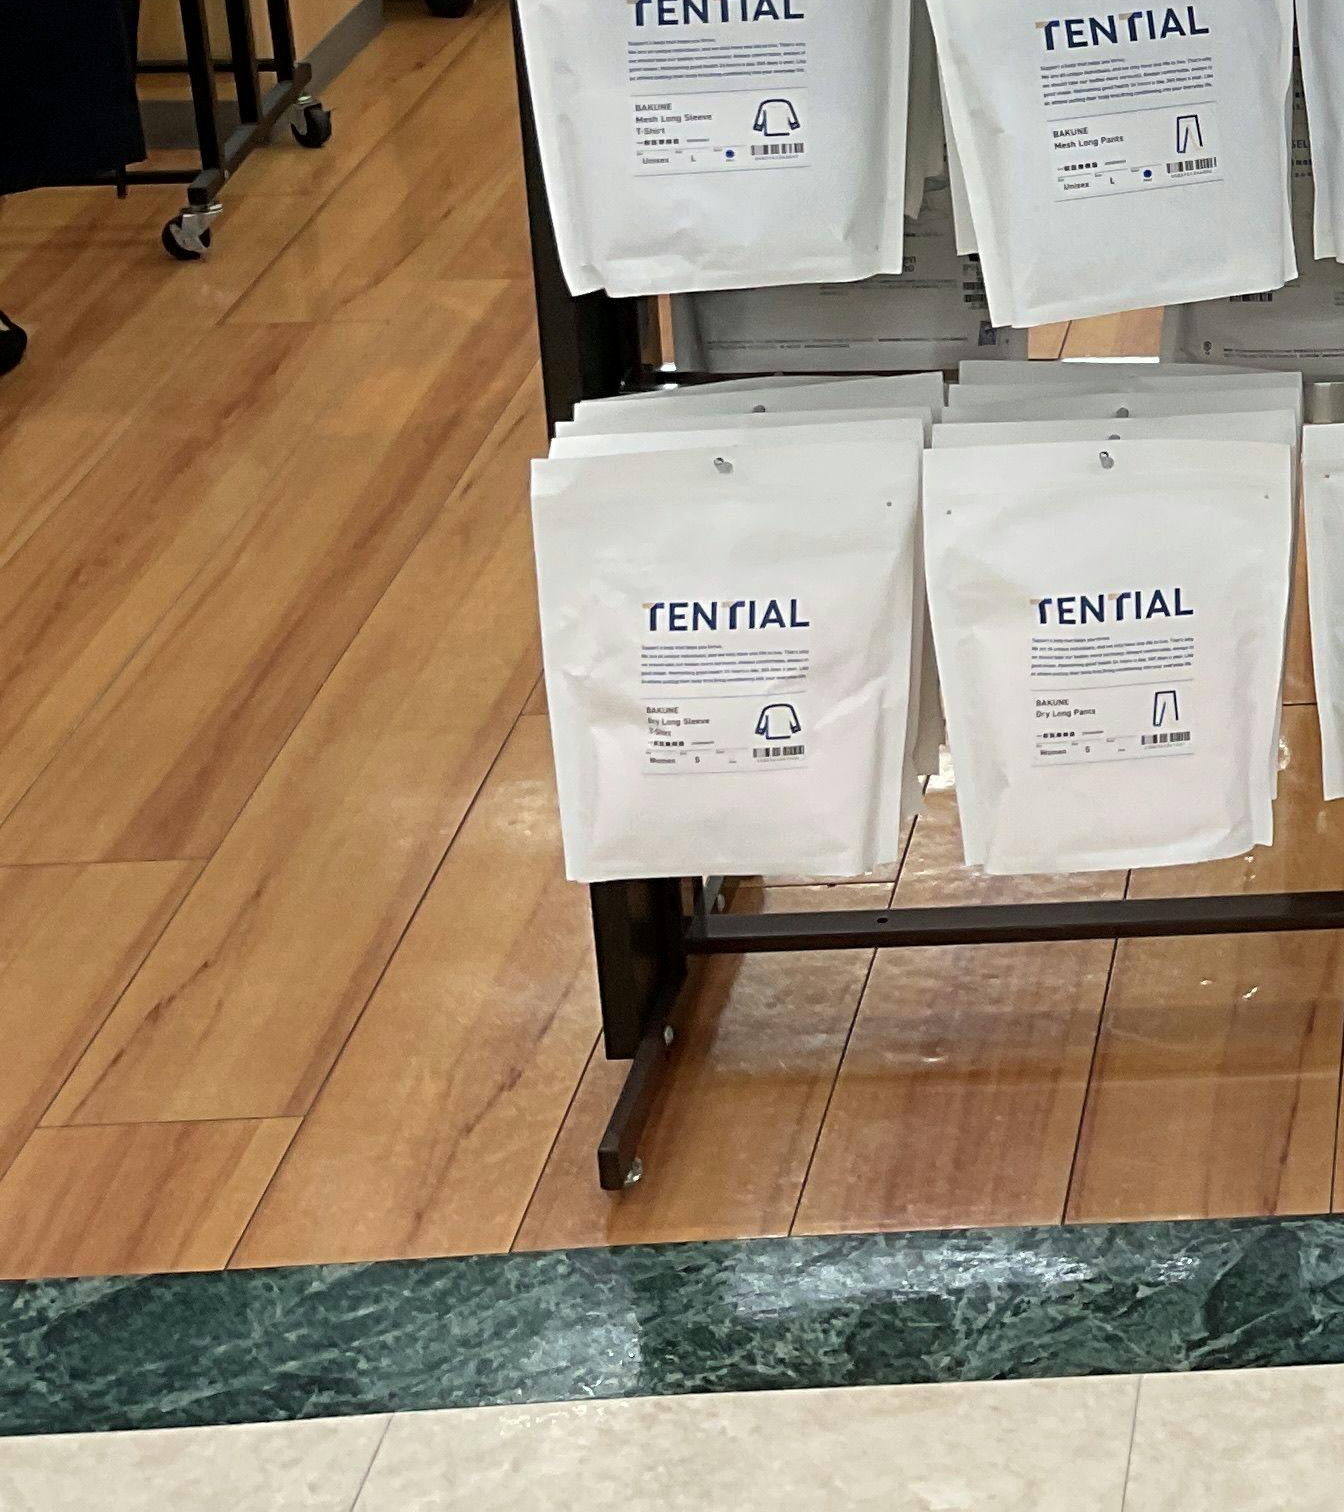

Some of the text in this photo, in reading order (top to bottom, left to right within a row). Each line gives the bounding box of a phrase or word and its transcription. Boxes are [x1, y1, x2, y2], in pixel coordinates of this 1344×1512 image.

[1035, 6, 1209, 50] TENTIAL
[661, 115, 681, 123] Long
[685, 113, 712, 121] Sleeve
[1053, 127, 1088, 138] BAKUNE
[1054, 135, 1123, 150] Mesh Long Pants
[642, 599, 810, 631] TENTIAL
[1030, 588, 1193, 624] TENTIAL
